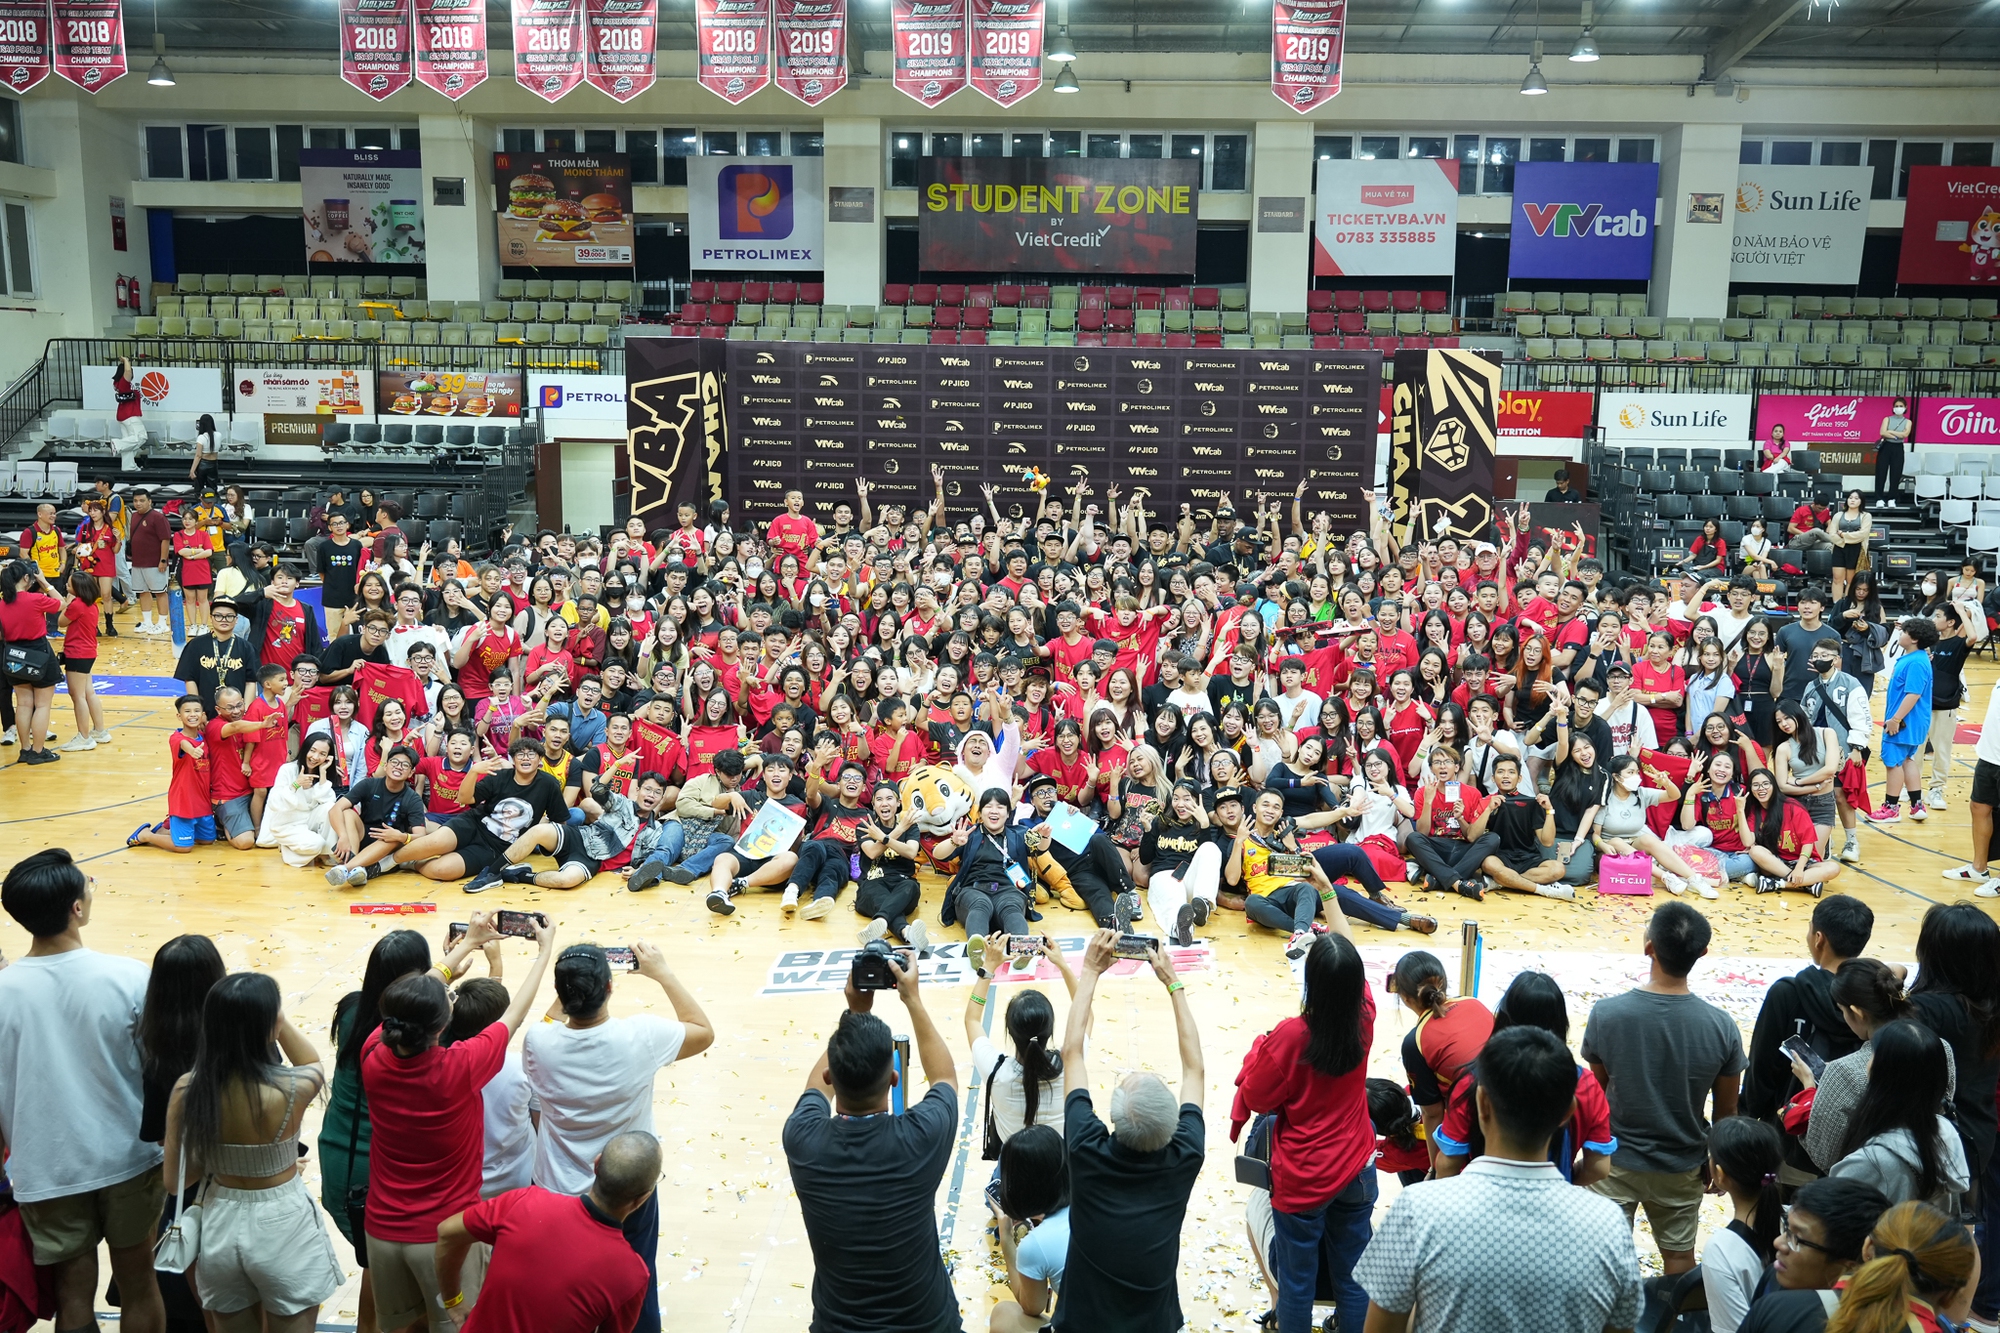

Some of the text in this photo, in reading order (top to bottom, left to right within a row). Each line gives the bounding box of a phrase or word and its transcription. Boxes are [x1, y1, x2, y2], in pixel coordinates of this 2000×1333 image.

[67, 21, 110, 42] 2018
[354, 28, 397, 49] 2018
[431, 27, 473, 49] 2018
[528, 29, 571, 51] 2018
[600, 29, 643, 51] 2018
[712, 30, 756, 52] 2018
[790, 31, 833, 53] 2019
[908, 33, 952, 55] 2019
[986, 32, 1030, 54] 2019
[1286, 37, 1330, 60] 2019
[357, 62, 400, 71] CHAMPIONS
[432, 62, 475, 70] CHAMPIONS
[530, 64, 573, 72] CHAMPIONS
[601, 64, 645, 72] CHAMPIONS
[713, 66, 757, 74] CHAMPIONS
[790, 68, 834, 76] CHAMPIONS
[909, 69, 953, 77] CHAMPIONS
[985, 68, 1029, 76] CHAMPIONS
[1283, 74, 1327, 83] CHAMPIONS
[354, 153, 379, 161] BLISS
[343, 173, 374, 181] NATURALLY
[1947, 181, 2000, 194] VietCre
[927, 183, 1190, 215] STUDENT ZONE
[1395, 191, 1410, 199] TẠI
[1769, 190, 1861, 211] Sun Life
[1692, 204, 1719, 212] SIDE A
[1050, 218, 1064, 226] BY
[1327, 213, 1446, 225] TICKET.VBA.VN
[1522, 202, 1648, 238] VTVcab
[1015, 231, 1102, 247] VietCredit
[1336, 232, 1436, 243] 0783 335885
[1744, 234, 1777, 248] NĂM
[1779, 234, 1810, 248] BẢO
[577, 248, 590, 257] 39
[702, 249, 812, 260] PETROLIMEX
[1773, 251, 1806, 267] VIỆT
[941, 357, 970, 366] VTVcab
[1131, 360, 1160, 369] VTVcab
[1260, 362, 1289, 370] VTVcab
[438, 373, 467, 394] 39
[752, 375, 780, 384] VTVcab
[1004, 380, 1033, 389] VTVcab
[1195, 383, 1224, 391] VTVcab
[1323, 385, 1353, 393] VTVcab
[815, 398, 843, 406] VTVcab
[1258, 405, 1287, 413] VTVcab
[752, 418, 781, 426] VTVcab
[1650, 410, 1728, 427] Sun Life
[271, 422, 317, 434] PREMIUM
[1130, 425, 1159, 433] VTVcab
[1321, 428, 1350, 436] VTVcab
[1496, 427, 1541, 436] UTRITION
[631, 371, 700, 515] VBA
[815, 440, 844, 448] VTVcab
[1192, 447, 1221, 455] VTVcab
[1819, 451, 1862, 464] REMIUM
[1128, 467, 1157, 475] VTVcab
[1255, 469, 1284, 477] VTVcab
[1833, 686, 1847, 707] G
